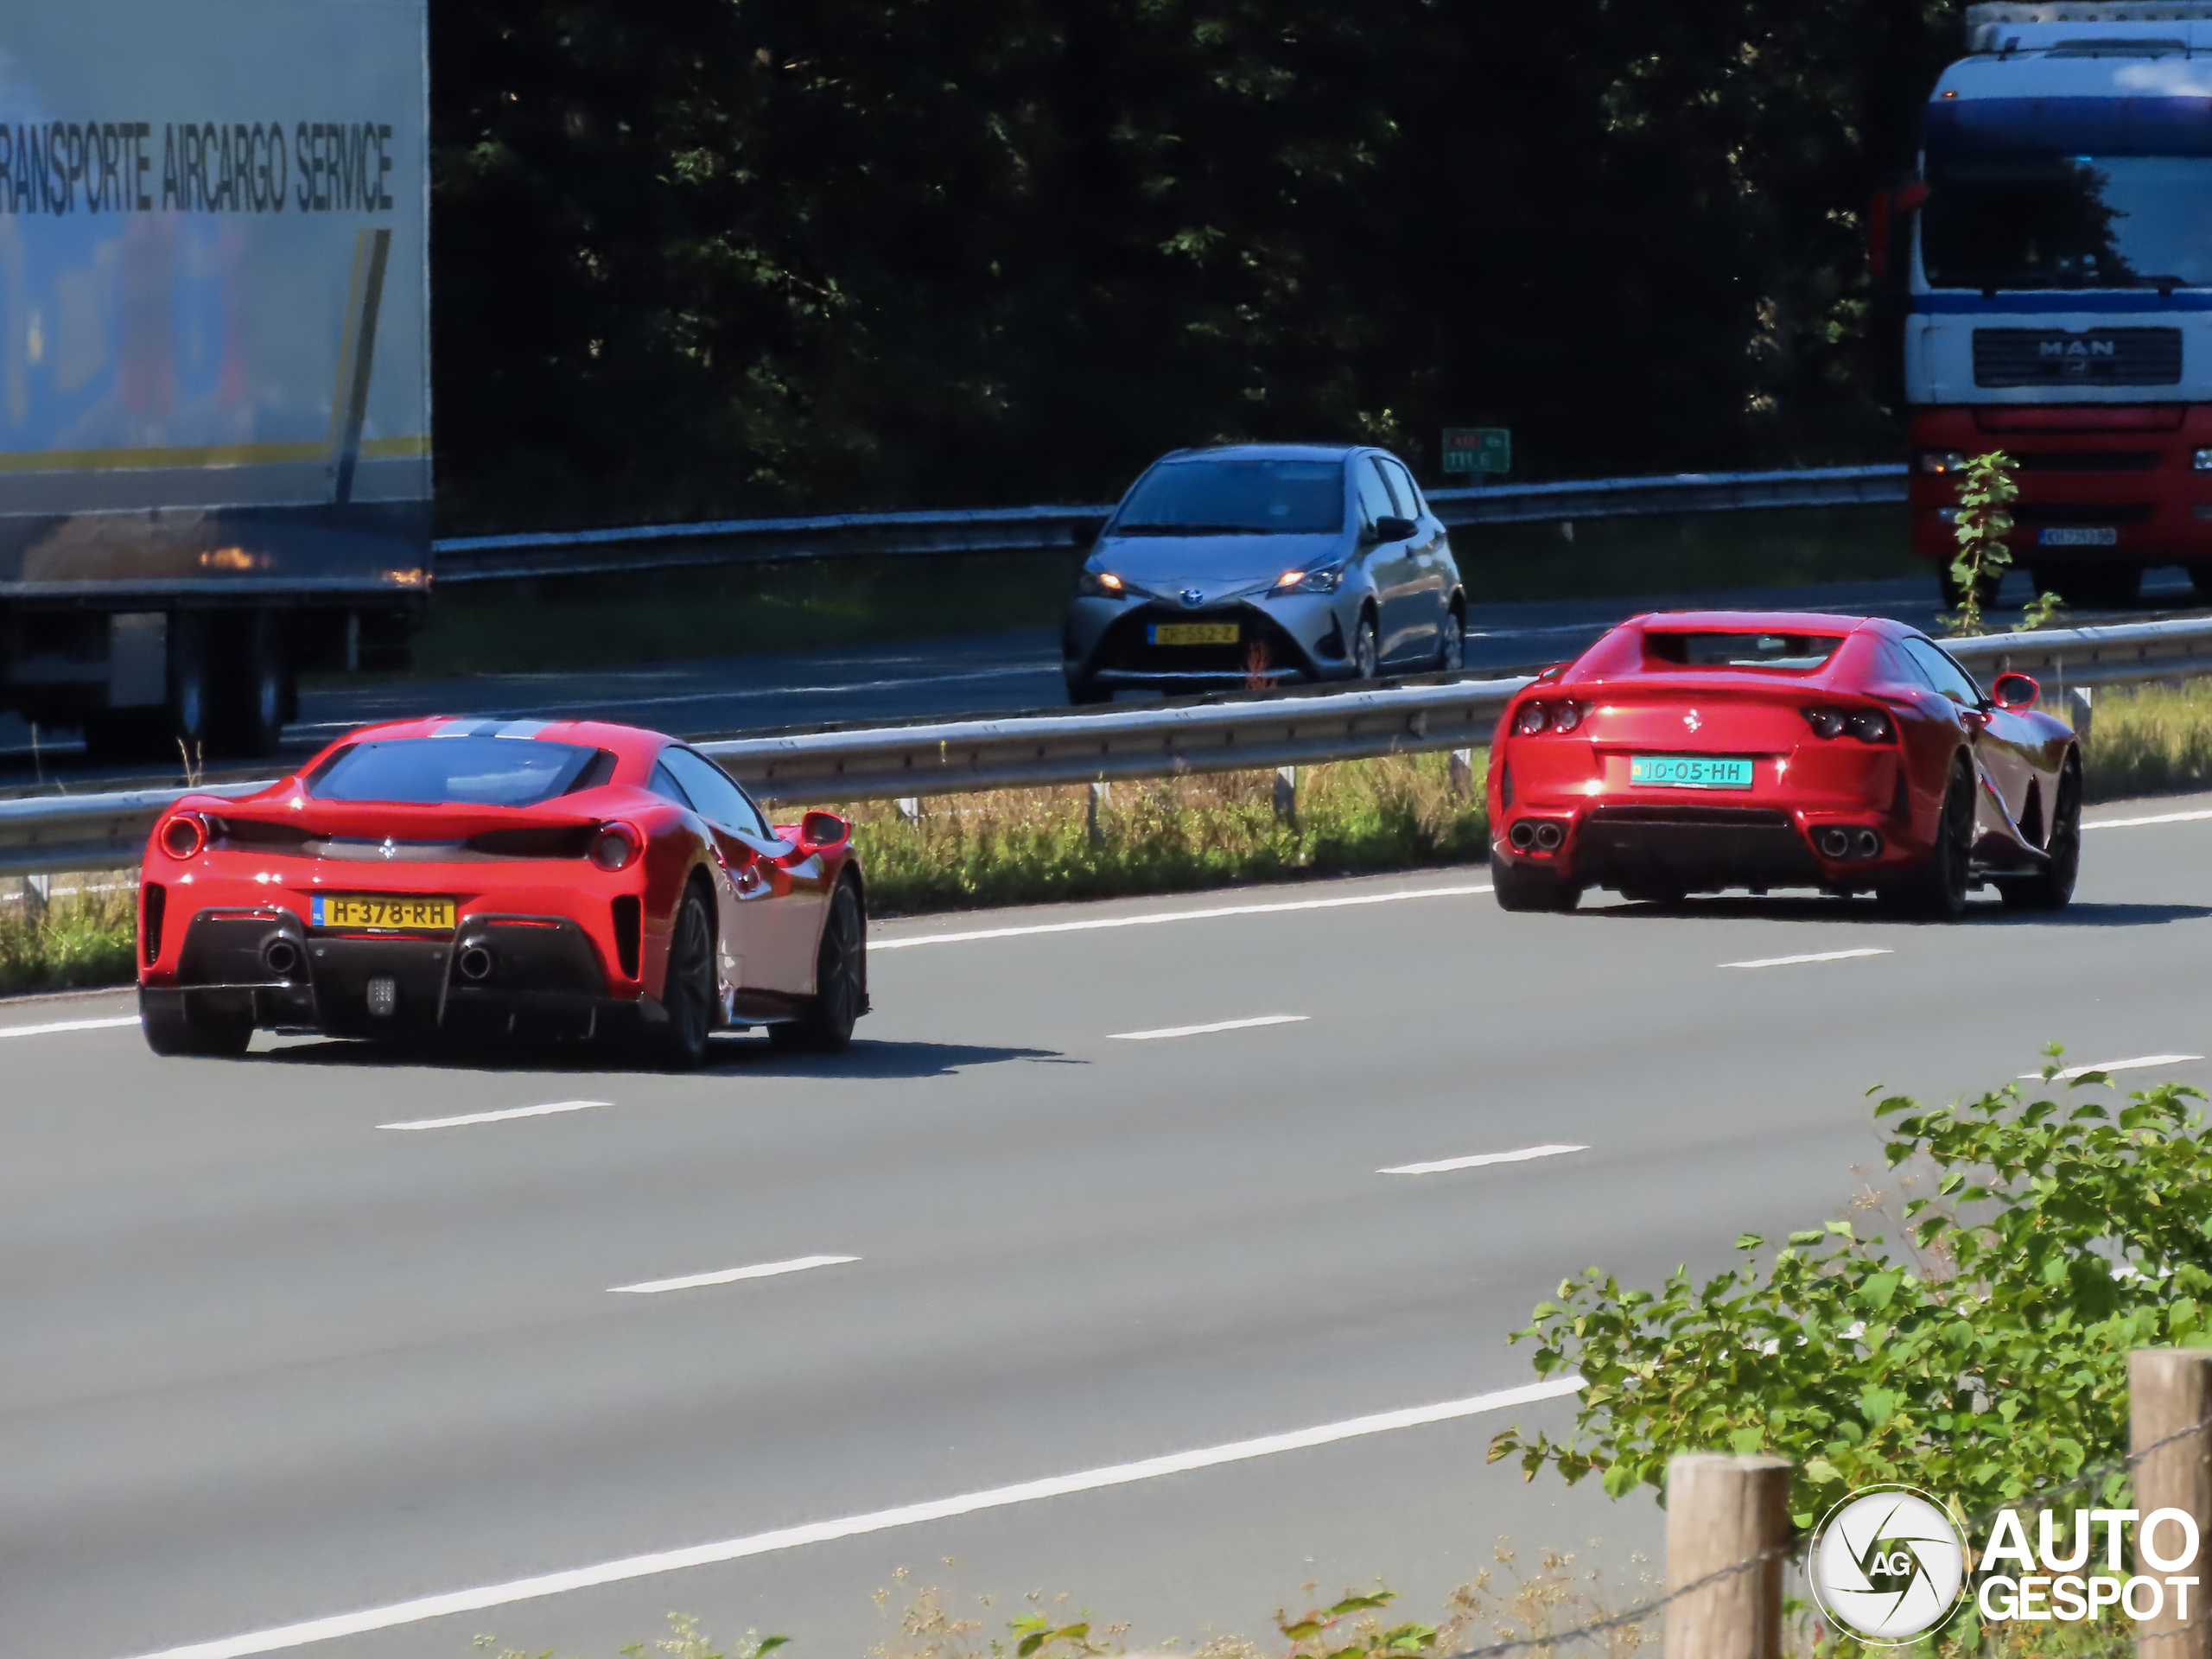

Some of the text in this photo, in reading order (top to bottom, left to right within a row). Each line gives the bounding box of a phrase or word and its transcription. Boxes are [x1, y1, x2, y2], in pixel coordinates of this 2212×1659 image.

[163, 121, 286, 213] AIRCARGO
[296, 121, 392, 213] SERVICE
[2040, 341, 2113, 356] MAN
[1645, 761, 1740, 780] 10-05-HH
[334, 900, 445, 925] H-378-RH
